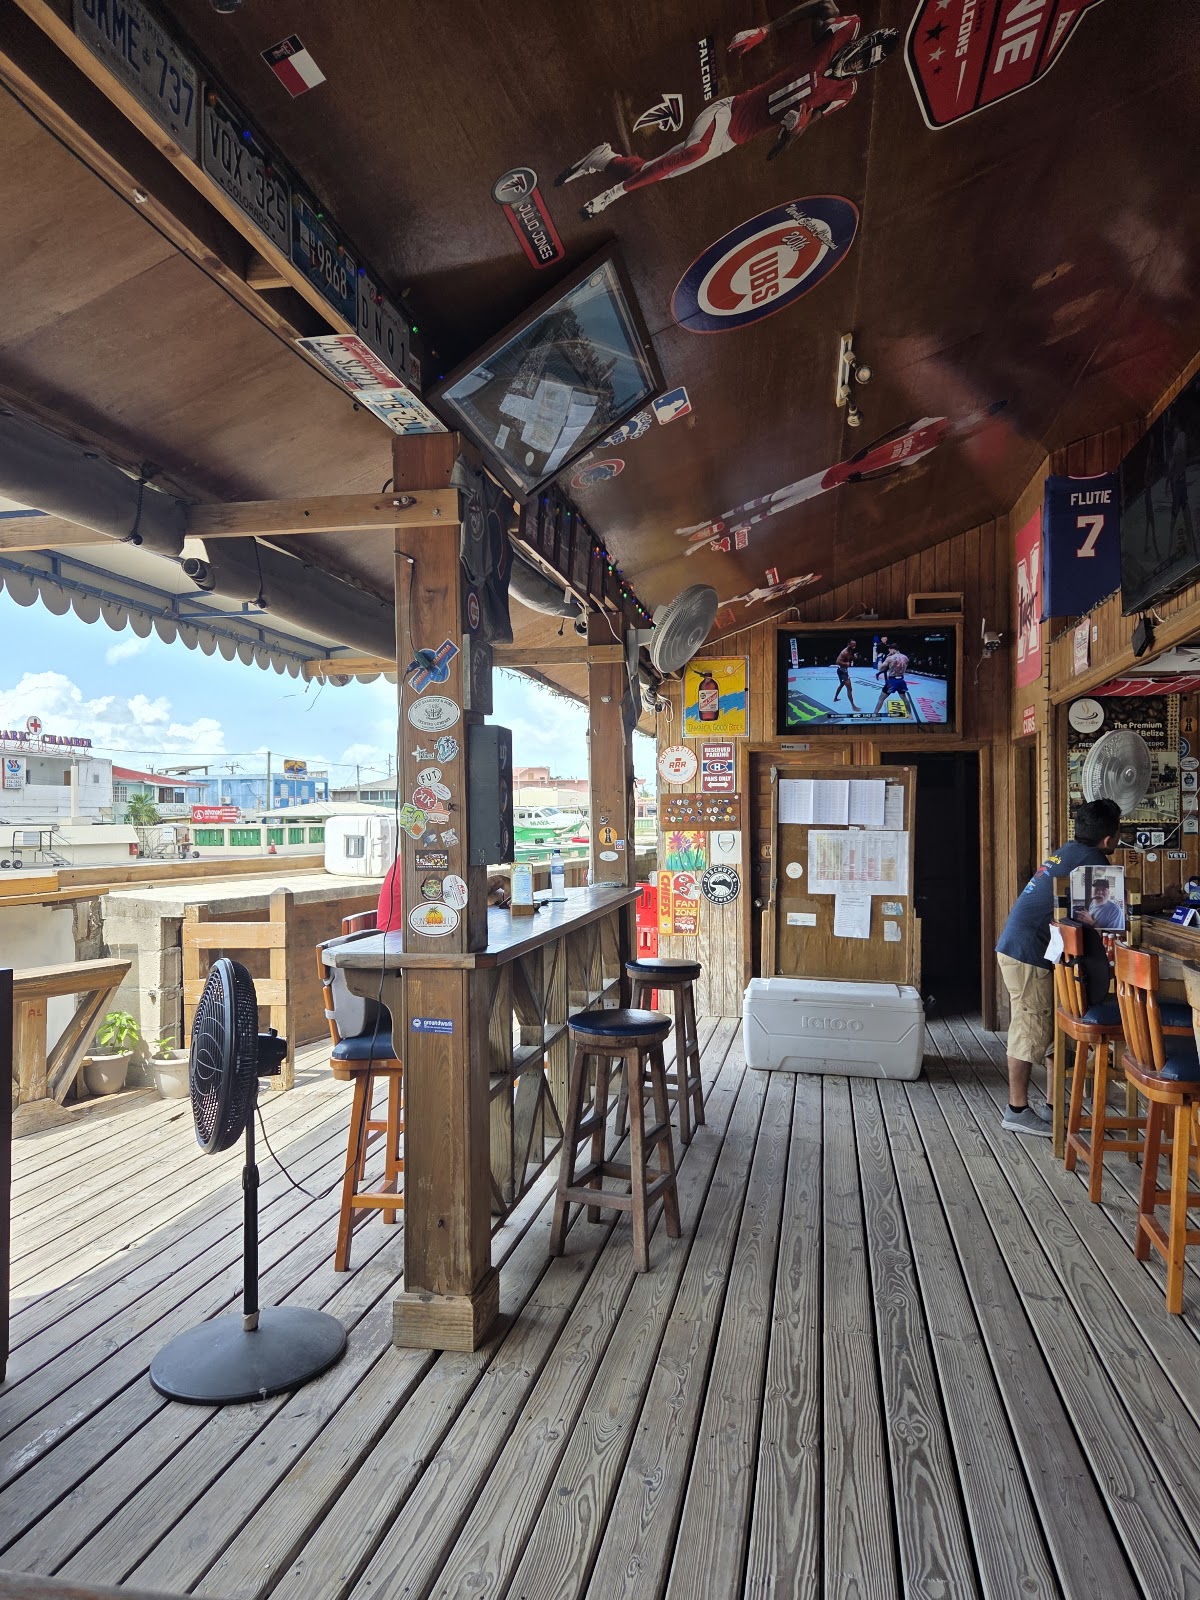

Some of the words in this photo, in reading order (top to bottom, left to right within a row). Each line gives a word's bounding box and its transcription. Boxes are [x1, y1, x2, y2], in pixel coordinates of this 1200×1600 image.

[698, 37, 712, 101] FALCONS
[155, 47, 194, 128] 737
[767, 73, 812, 116] 11
[227, 180, 270, 231] COLORADO
[518, 203, 541, 232] JULIO
[532, 230, 554, 260] JONES
[781, 231, 811, 252] 2016
[317, 240, 348, 300] 9868
[1070, 489, 1112, 506] FLUTIE
[1075, 514, 1105, 558] 7
[41, 734, 93, 748] CHAMBER
[420, 770, 438, 784] FUT
[703, 866, 738, 882] DESCHUTES
[675, 909, 697, 917] ZONE
[801, 1015, 864, 1031] IGLOO
